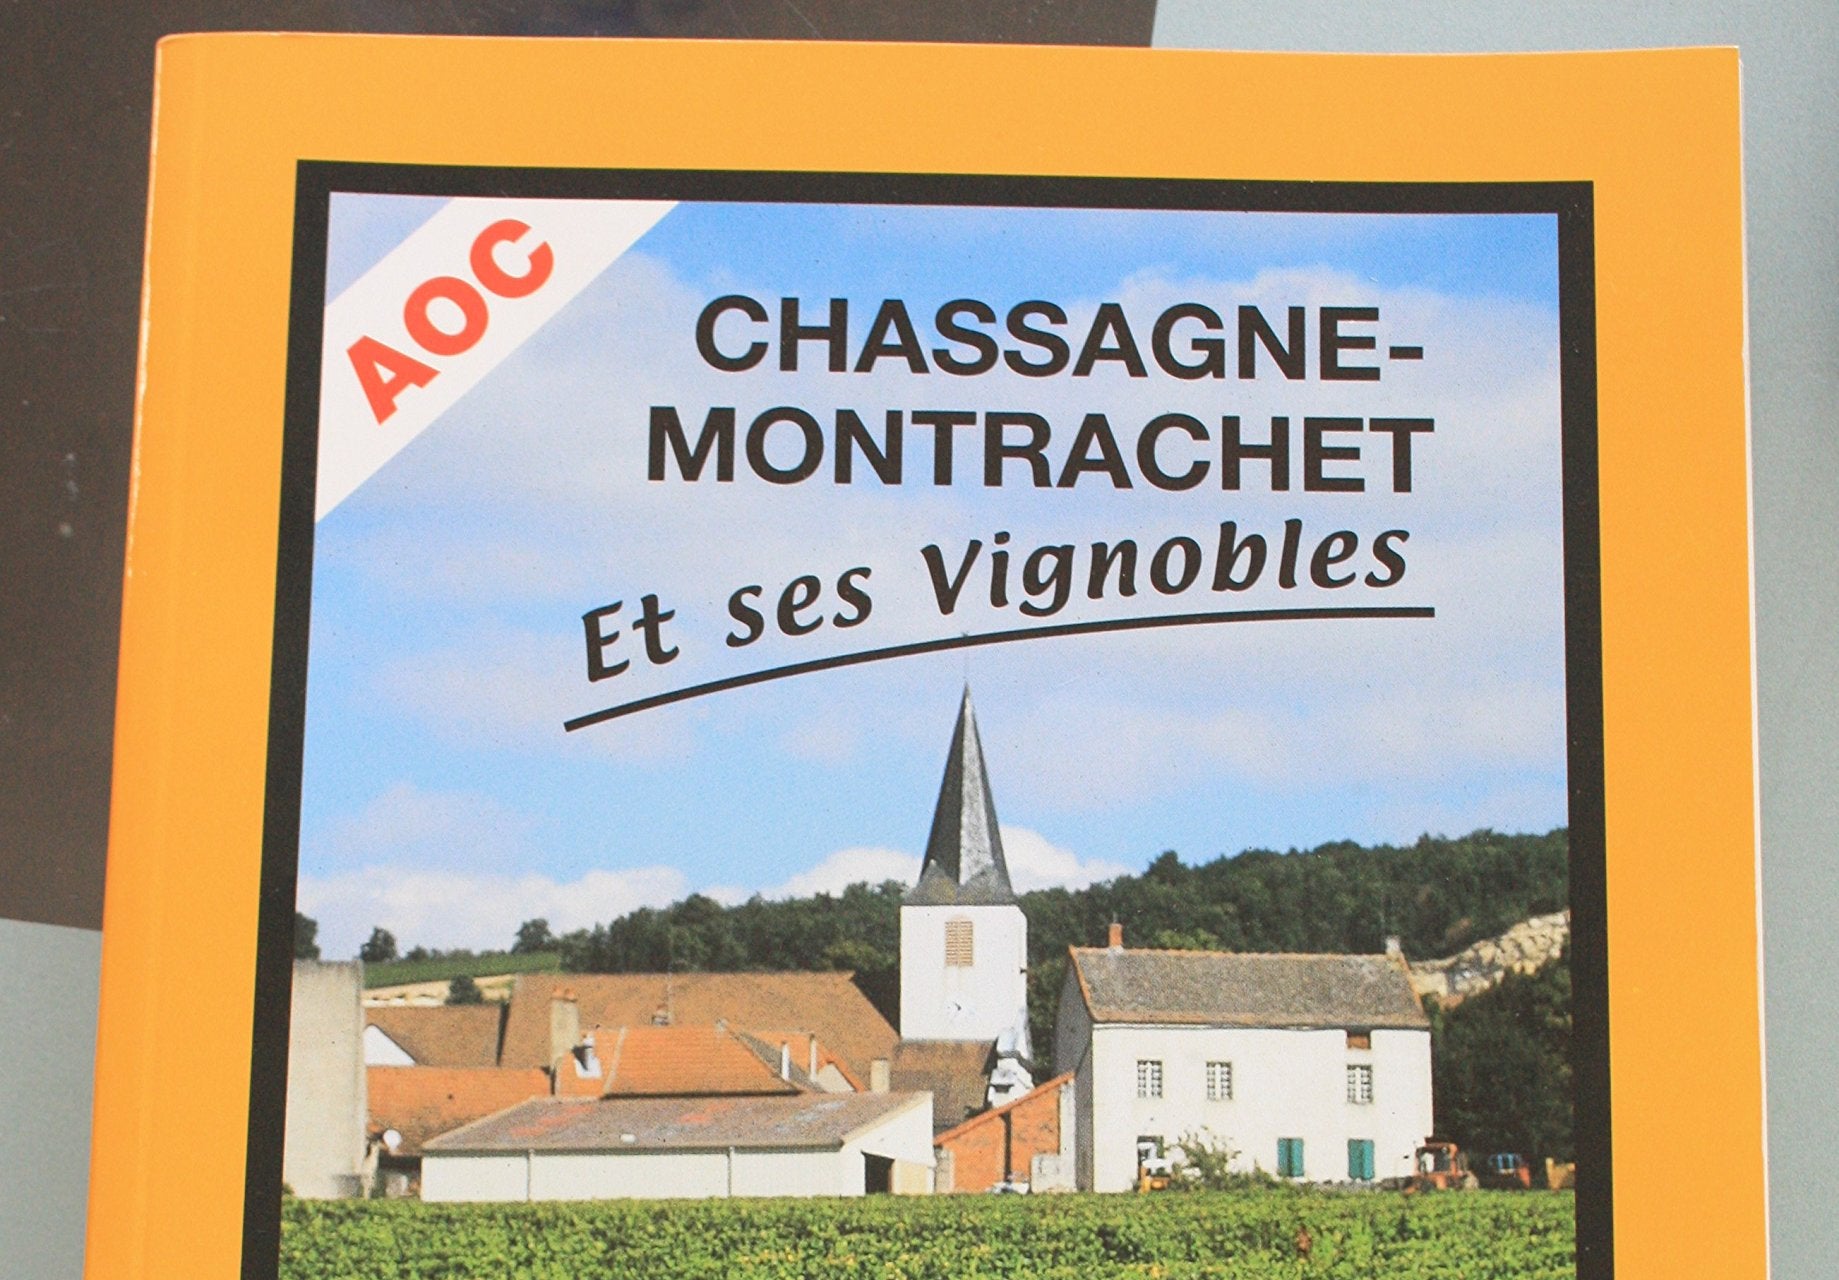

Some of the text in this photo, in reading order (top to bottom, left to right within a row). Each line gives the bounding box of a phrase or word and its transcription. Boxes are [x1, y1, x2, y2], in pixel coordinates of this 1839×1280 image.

[347, 219, 554, 425] AOC
[695, 294, 1424, 381] CHASSAGNE-
[648, 406, 1435, 493] MONTRACHET
[582, 518, 1410, 683] Et ses Vignobles
